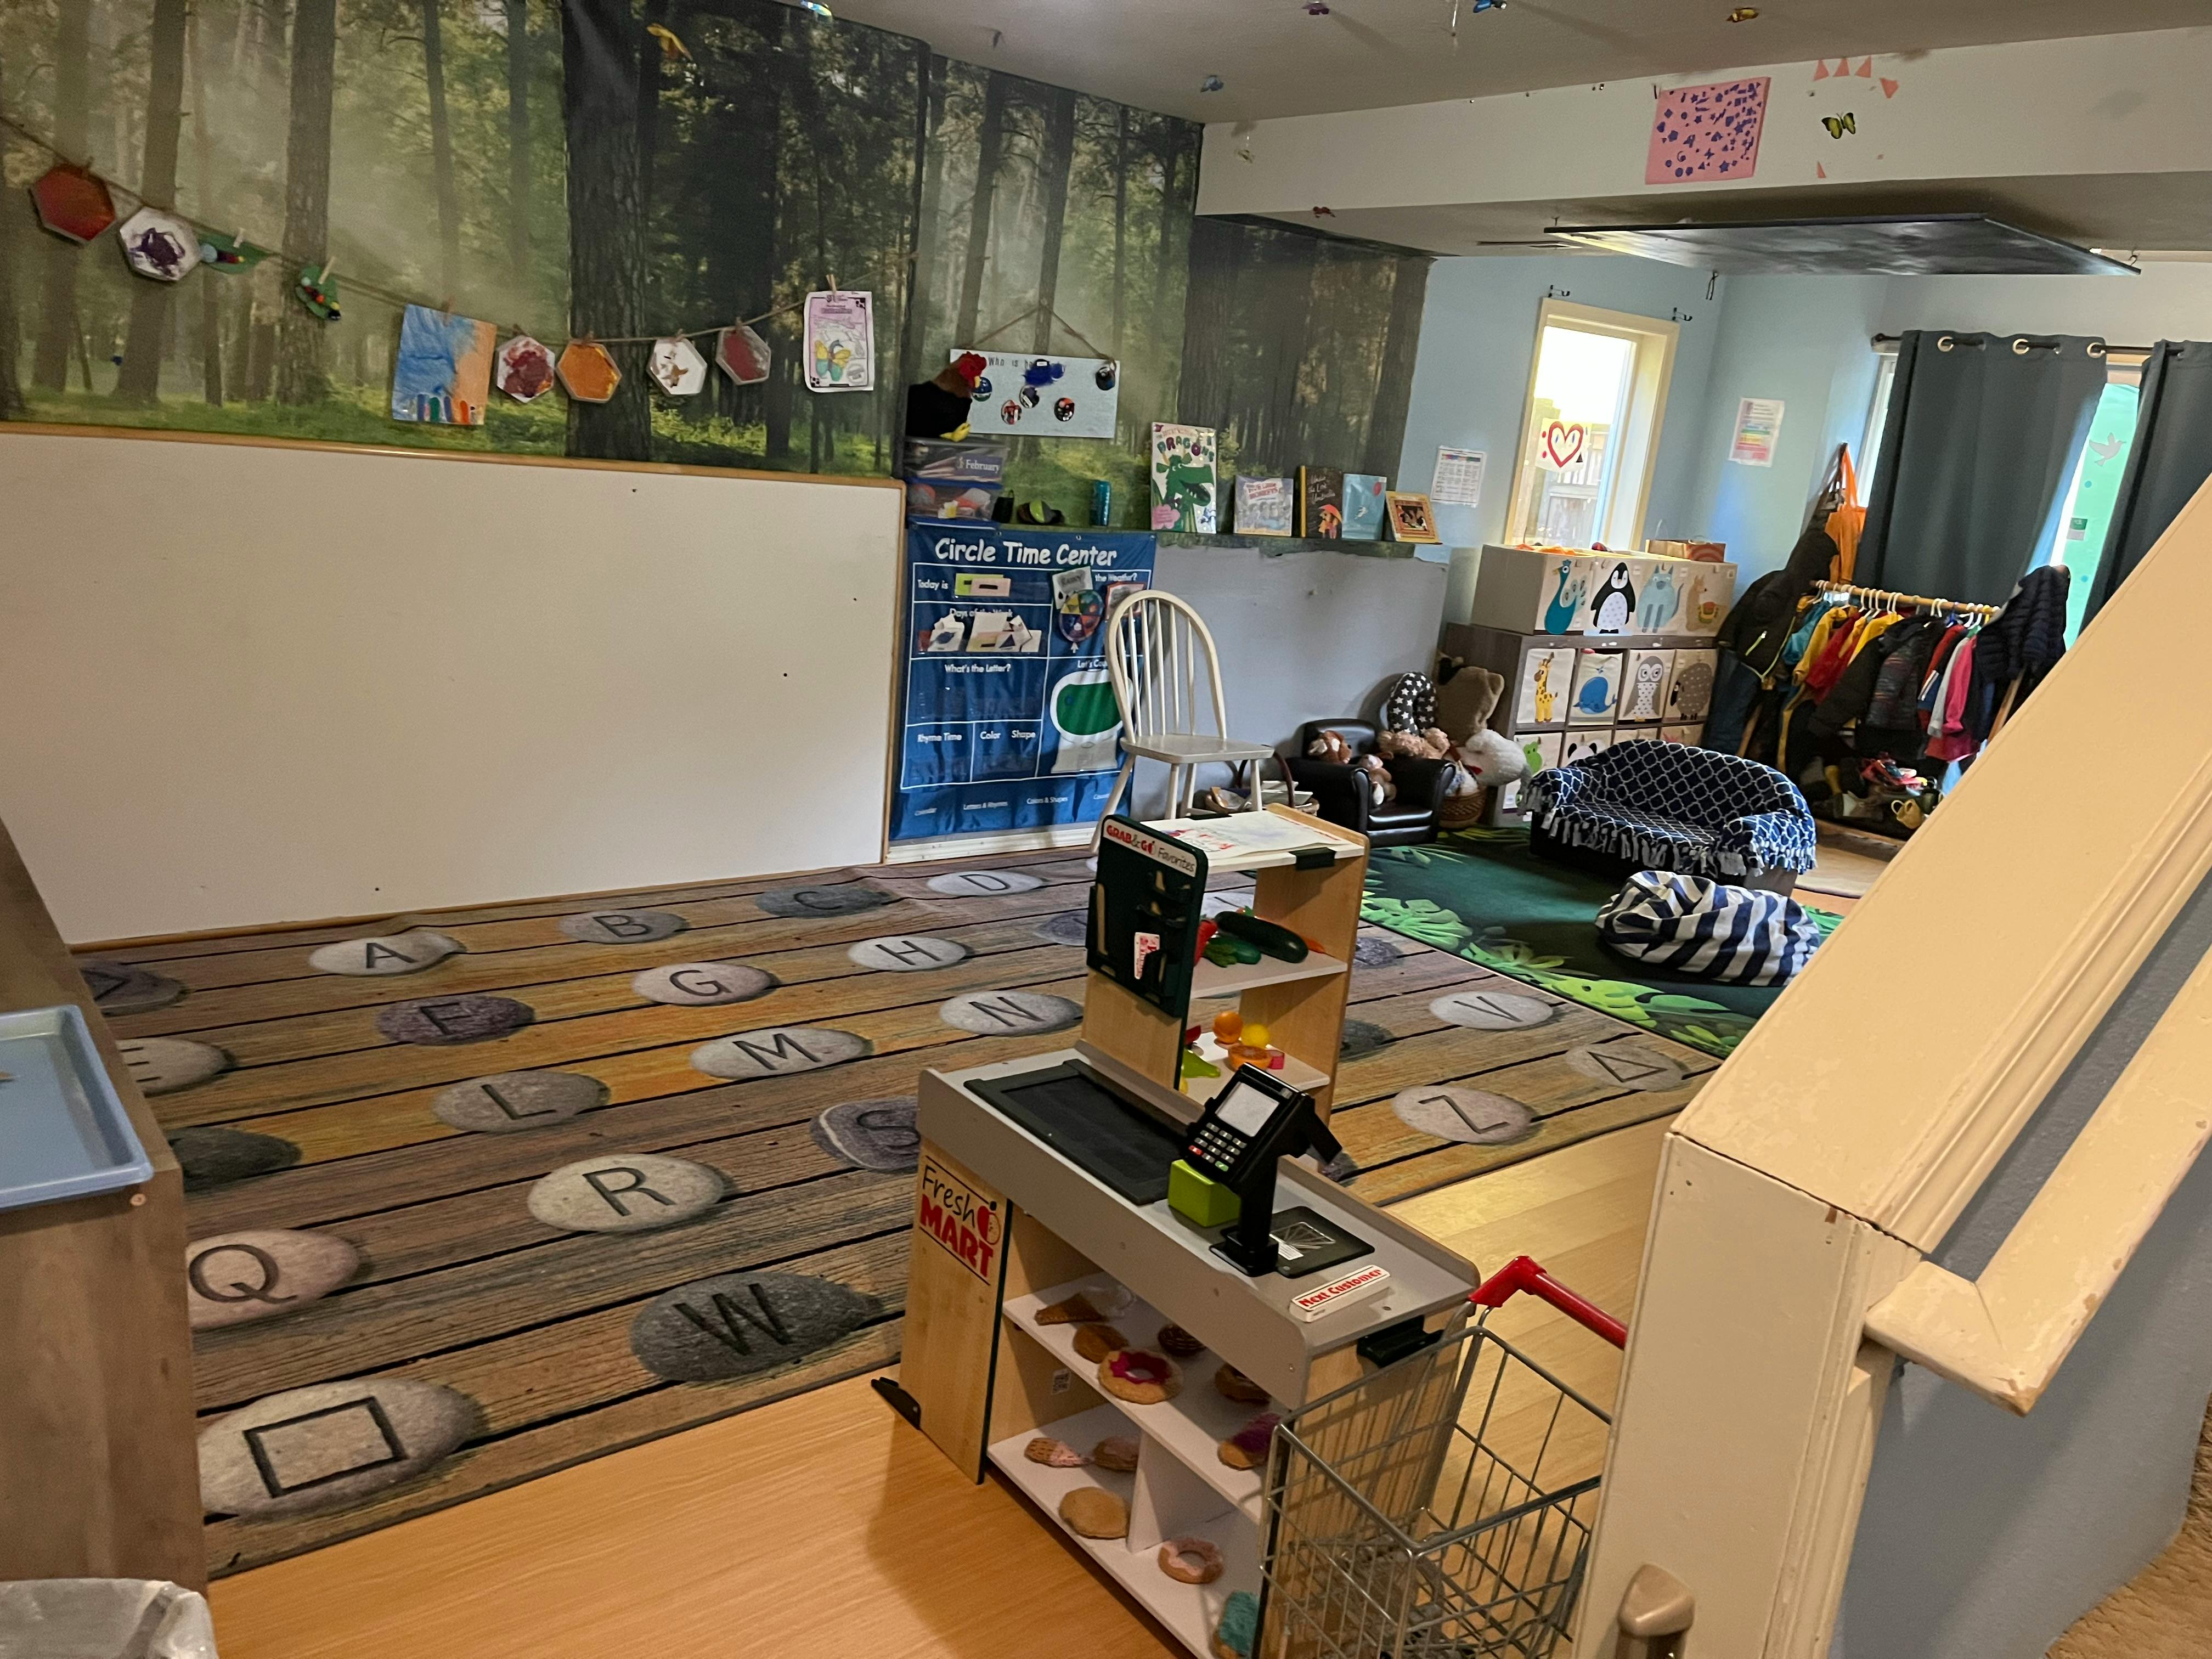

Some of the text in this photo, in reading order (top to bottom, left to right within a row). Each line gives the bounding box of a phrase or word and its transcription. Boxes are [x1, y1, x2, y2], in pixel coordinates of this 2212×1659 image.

[989, 357, 1005, 366] Who
[966, 459, 1000, 473] February
[935, 538, 1117, 566] Circle Time Center
[917, 579, 949, 591] Today is
[949, 608, 967, 619] Days
[944, 664, 970, 673] What's
[971, 664, 984, 673] the
[917, 732, 962, 743] Rhyme Time
[980, 731, 1001, 740] Color
[1011, 730, 1036, 740] Shape
[1158, 847, 1195, 872] Favorites
[959, 873, 1012, 891] D
[793, 890, 840, 911] C
[592, 913, 653, 939] B
[365, 941, 417, 969] A
[875, 939, 940, 966] H
[669, 969, 733, 998] G
[420, 1001, 462, 1036] F
[967, 996, 1045, 1029] N
[731, 1032, 822, 1071] M
[481, 1083, 557, 1120] L
[1418, 1094, 1511, 1135] Z
[582, 1166, 678, 1217] R
[922, 1164, 975, 1229] Fresh
[920, 1193, 994, 1278] MART
[189, 1244, 298, 1305] Q
[1298, 1269, 1383, 1307] Next Customer
[673, 1283, 793, 1357] W
